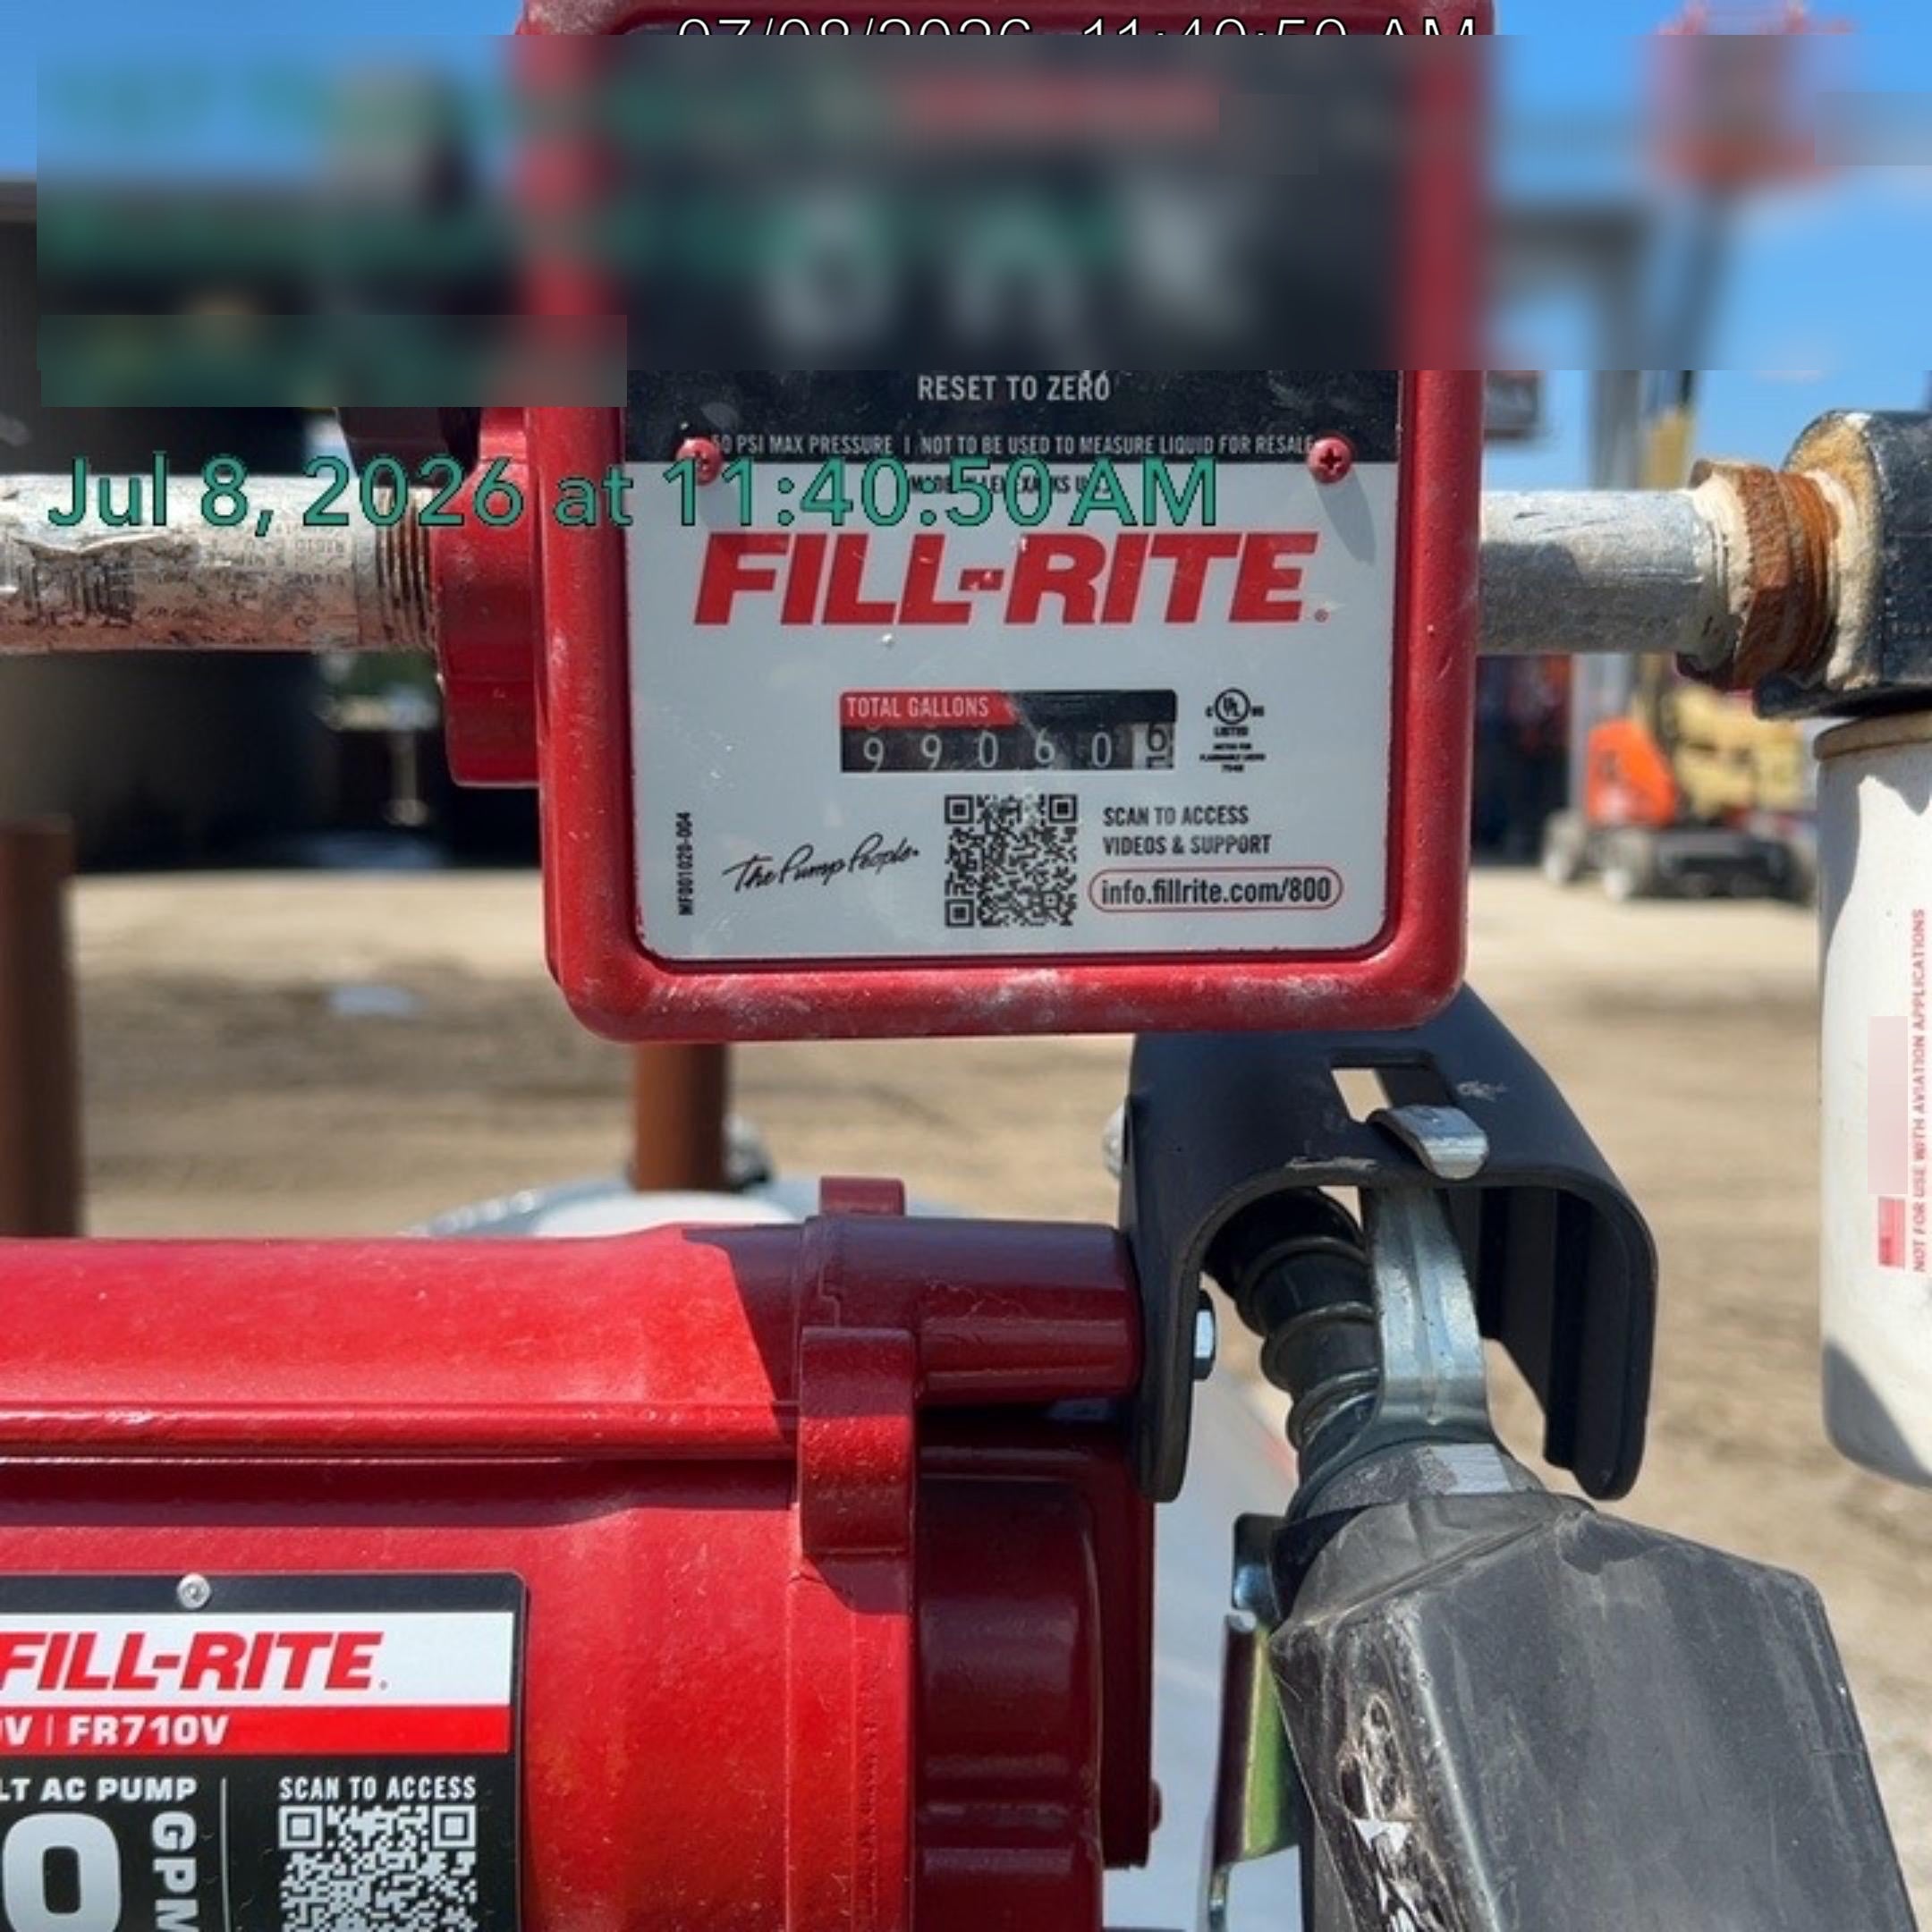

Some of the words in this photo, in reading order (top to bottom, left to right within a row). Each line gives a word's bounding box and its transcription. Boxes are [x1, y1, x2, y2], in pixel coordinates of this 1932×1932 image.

[917, 375, 997, 402] RESET
[1006, 375, 1038, 402] TO
[1046, 374, 1110, 402] ZERO
[737, 435, 764, 454] PSI
[769, 435, 803, 454] MAX
[809, 435, 894, 455] PRESSURE
[921, 435, 953, 455] NOT
[957, 435, 978, 455] TO
[982, 435, 1002, 455] BE
[1008, 435, 1050, 455] USED
[1055, 435, 1074, 455] TO
[1080, 435, 1155, 455] MEASURE
[1160, 435, 1214, 455] LIQUID
[1218, 435, 1250, 455] FOR
[694, 532, 1319, 624] FILL-RITE
[847, 696, 901, 717] TOTAL
[908, 696, 989, 717] GALLONS
[1102, 806, 1150, 826] SCAN
[1154, 806, 1176, 826] TO
[1181, 804, 1250, 826] ACCESS
[1102, 835, 1167, 856] VIDEOS
[1172, 835, 1186, 856] &
[1191, 834, 1272, 855] SUPPORT
[721, 852, 775, 893] The
[777, 843, 846, 886] Pump
[1101, 876, 1332, 905] info.fillrite.com/800
[1912, 909, 1927, 1030] APPLICATIONS
[1912, 1035, 1926, 1114] AVIATION
[68, 1715, 230, 1746] FR710V
[40, 1776, 87, 1801] AC
[97, 1776, 198, 1801] PUMP
[278, 1775, 340, 1801] SCAN
[349, 1775, 377, 1801] TO
[386, 1775, 476, 1801] ACCESS
